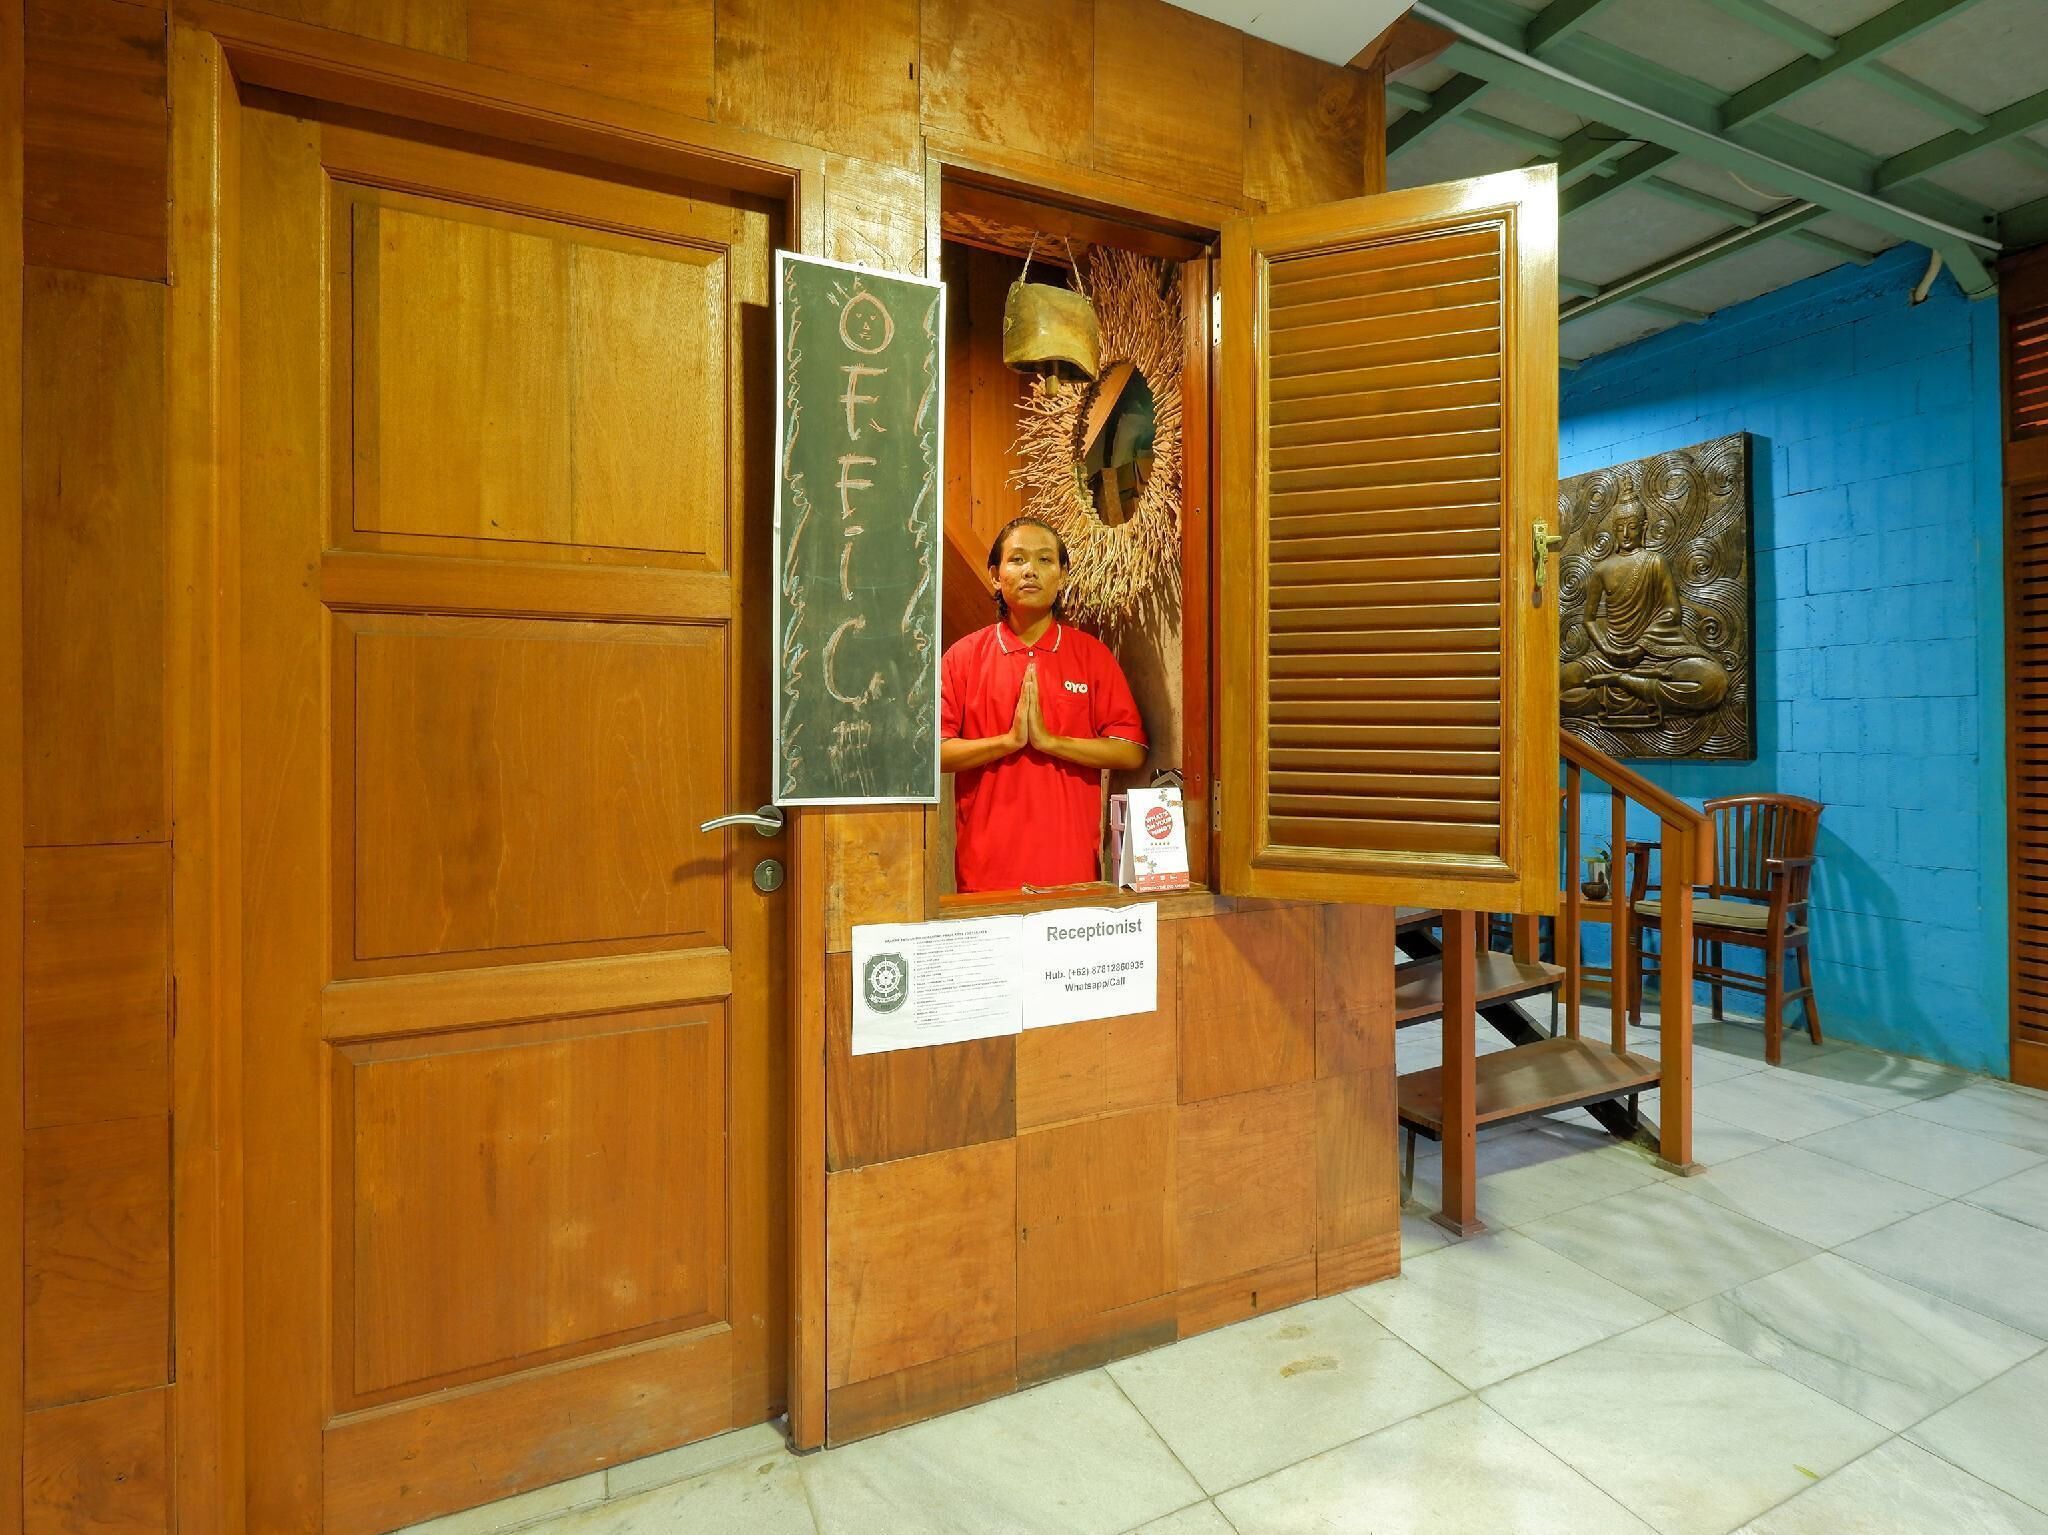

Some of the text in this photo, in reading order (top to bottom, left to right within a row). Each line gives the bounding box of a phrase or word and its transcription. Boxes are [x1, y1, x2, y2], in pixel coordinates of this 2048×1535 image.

[1064, 680, 1088, 693] OYO
[1047, 918, 1142, 941] Receptionist
[1045, 970, 1066, 980] Hub.
[1064, 976, 1126, 992] Whatsapp/Call
